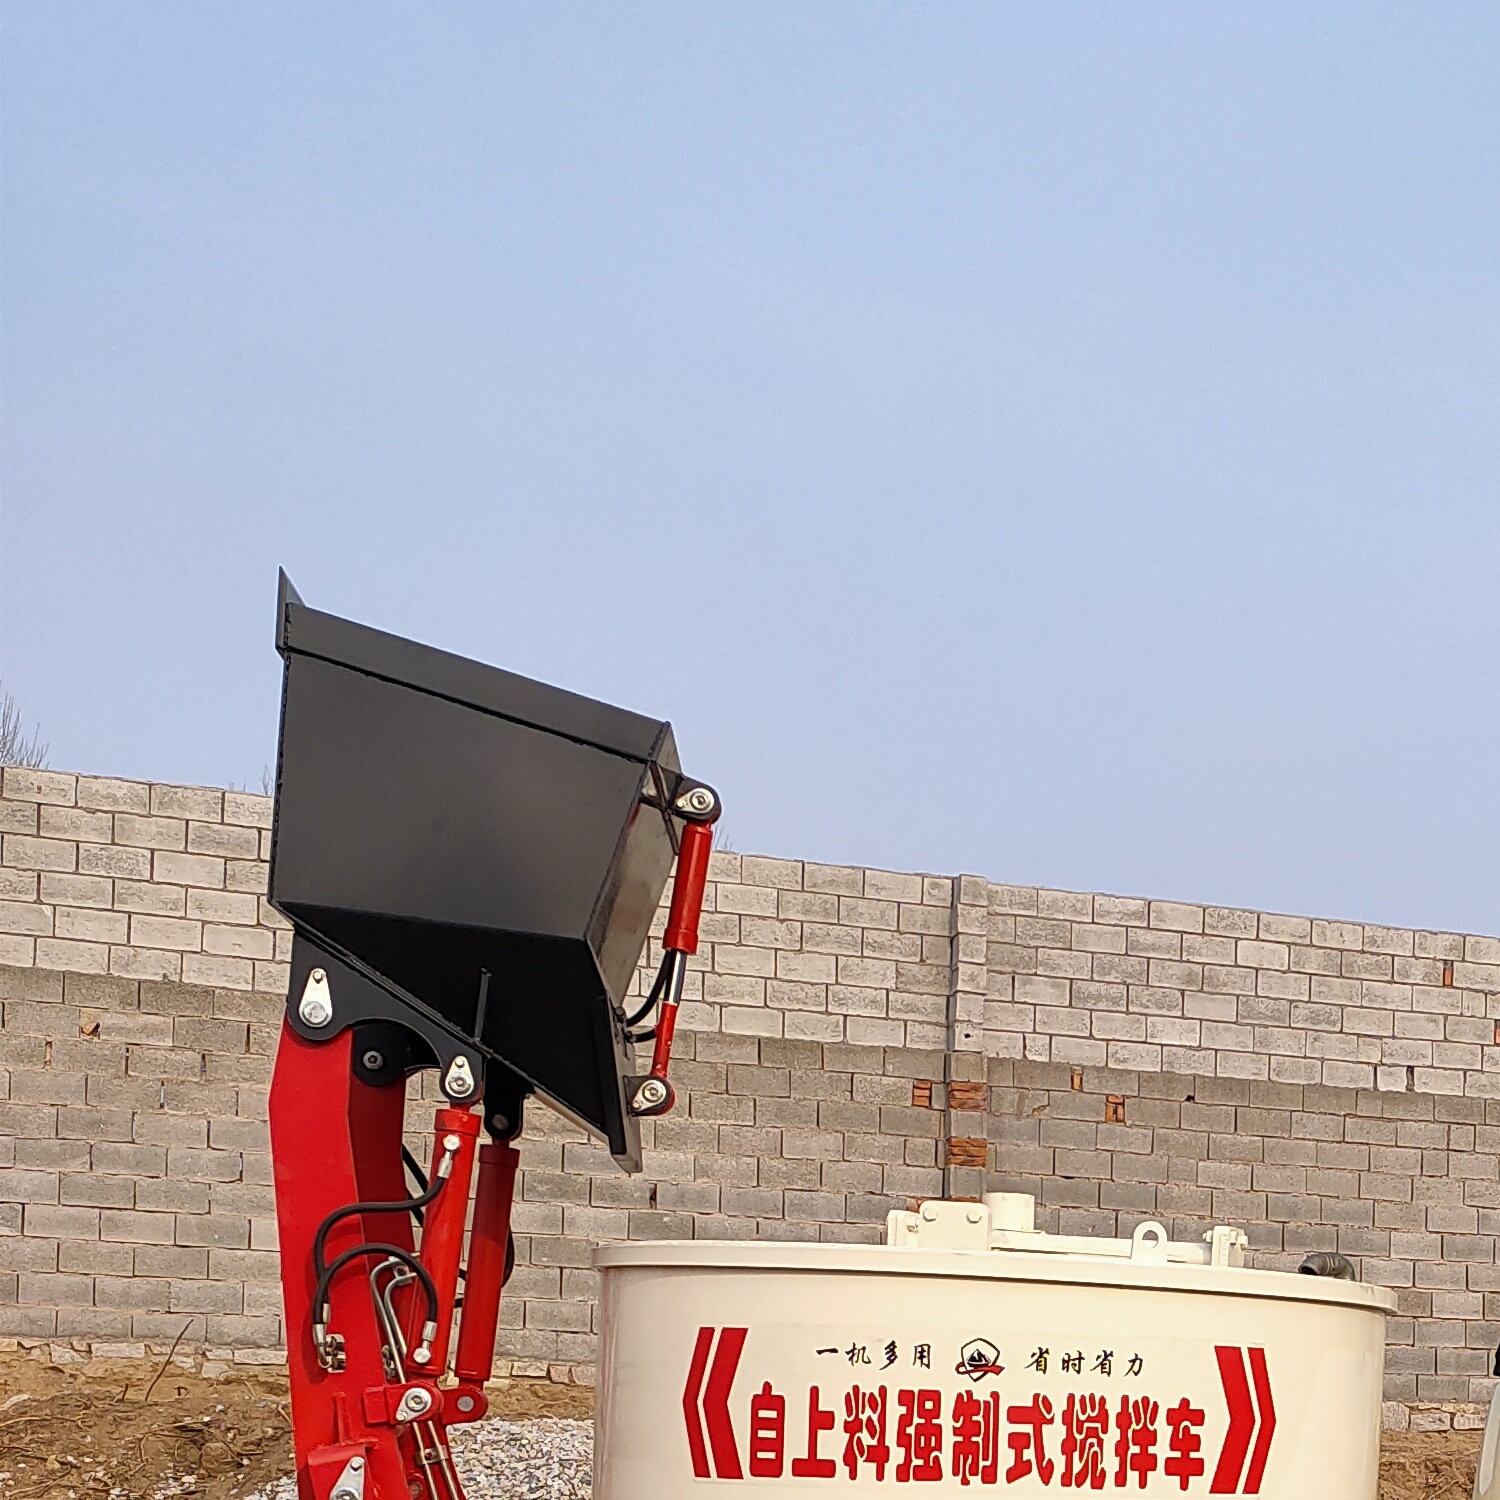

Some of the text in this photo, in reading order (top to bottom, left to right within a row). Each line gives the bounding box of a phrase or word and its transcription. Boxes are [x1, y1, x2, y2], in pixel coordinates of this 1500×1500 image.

[816, 1341, 931, 1370] 一机多用
[1025, 1347, 1144, 1377] 省时省力
[749, 1381, 1205, 1491] 自上料强制式搅拌车
